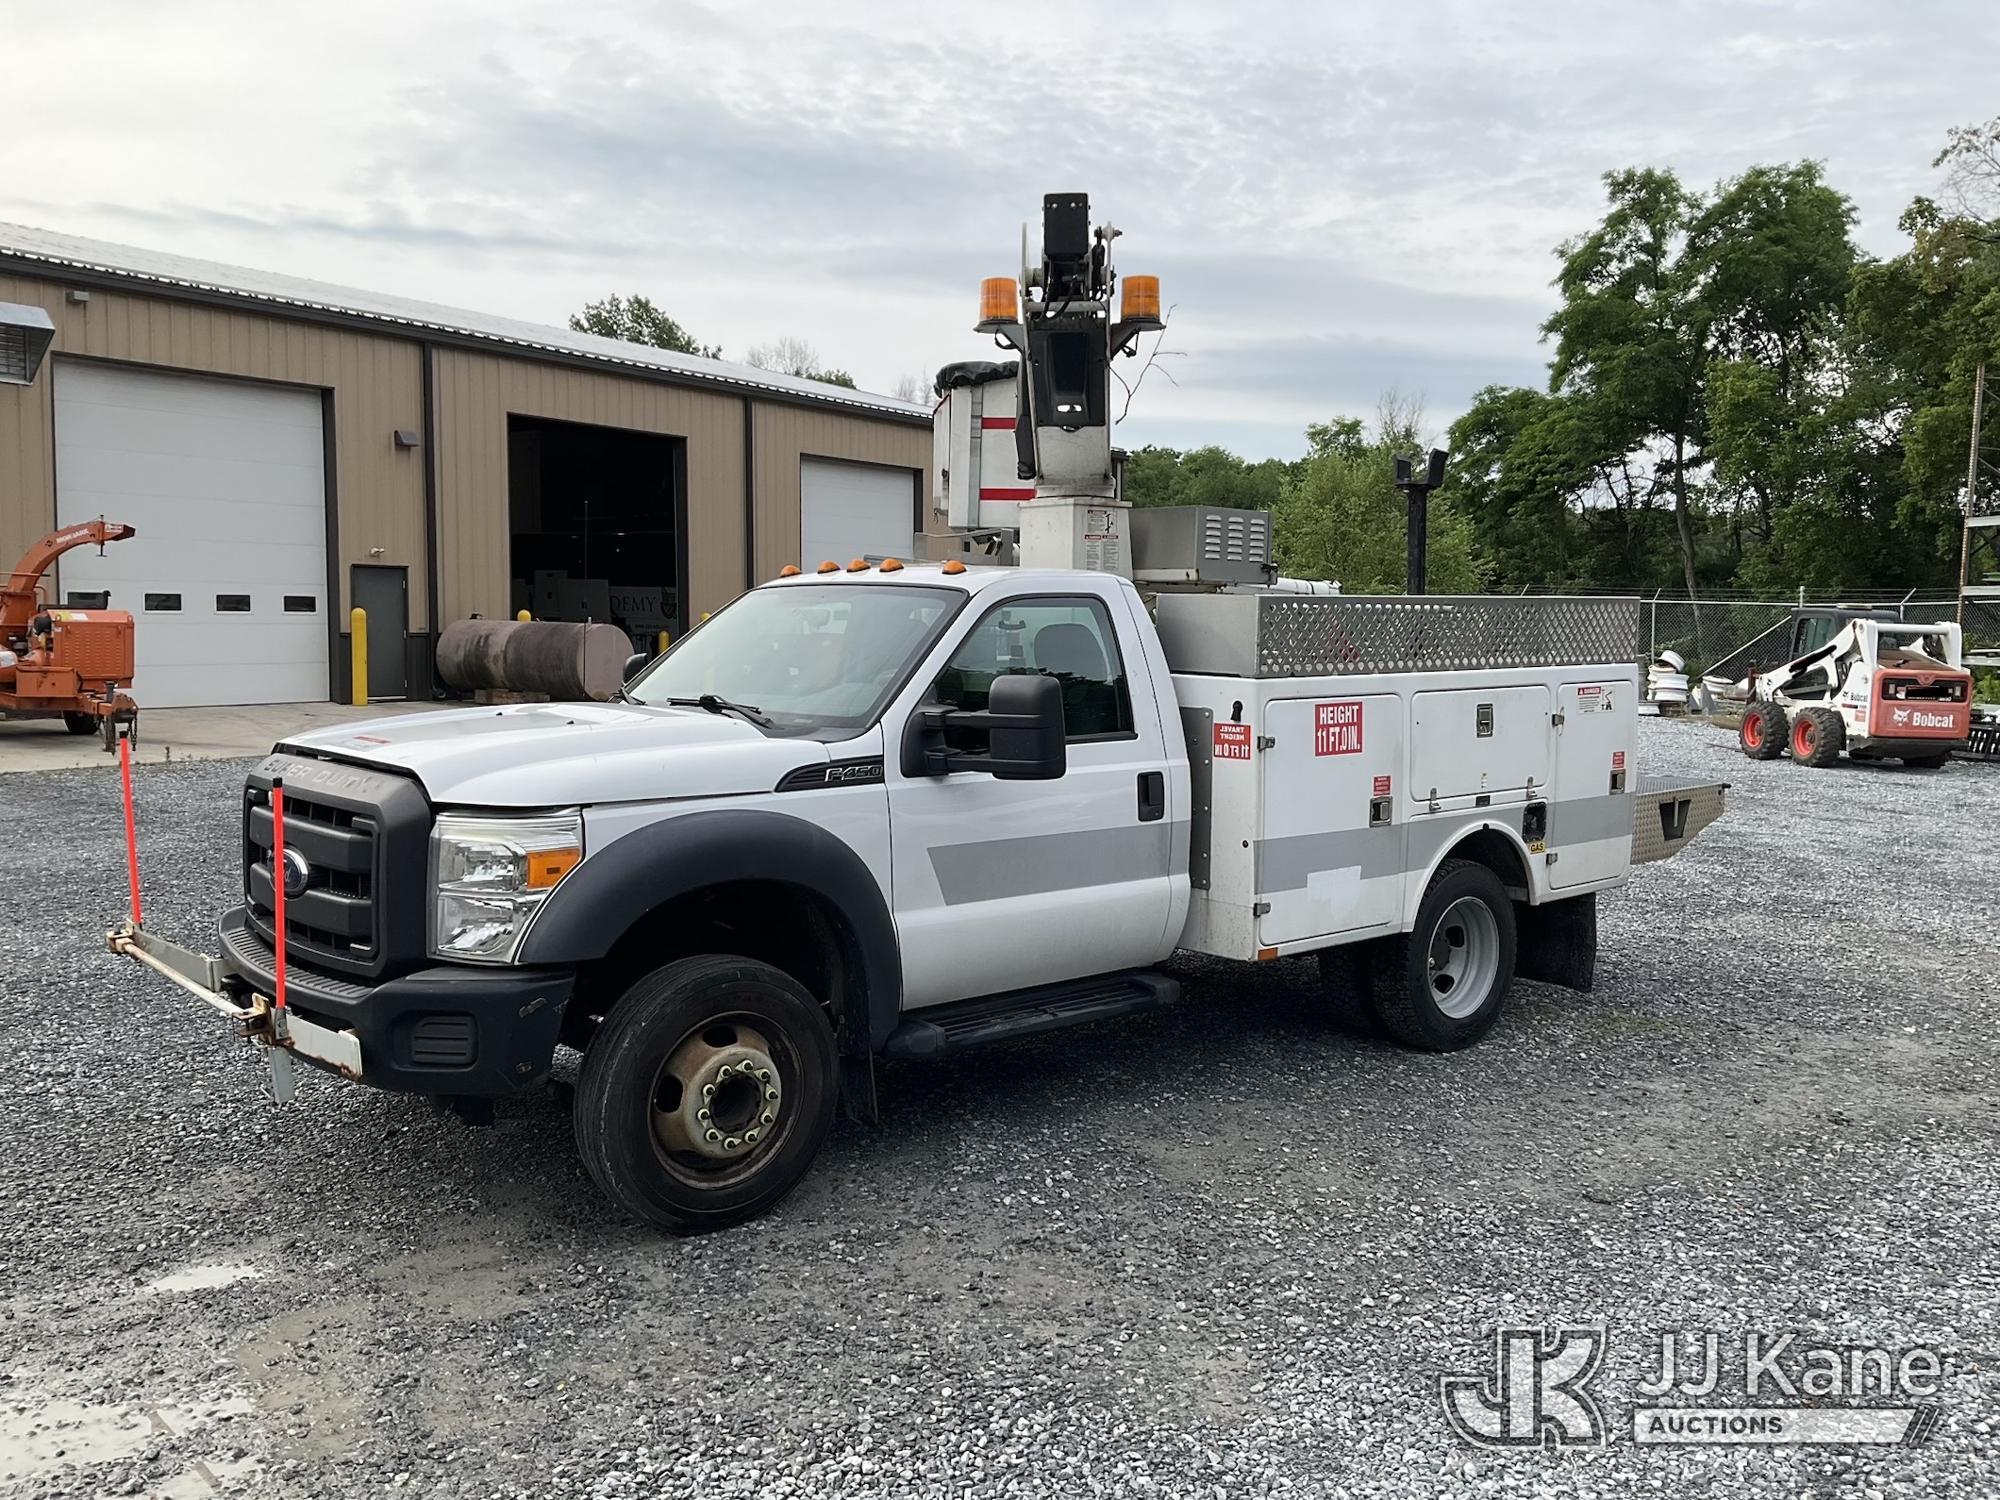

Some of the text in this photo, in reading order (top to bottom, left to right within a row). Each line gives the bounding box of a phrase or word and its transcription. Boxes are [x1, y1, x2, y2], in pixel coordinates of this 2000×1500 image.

[1320, 705, 1359, 725] HEIGHT
[1912, 712, 1954, 728] Bobcat
[1317, 727, 1327, 752] 11
[1530, 842, 1544, 852] GAS
